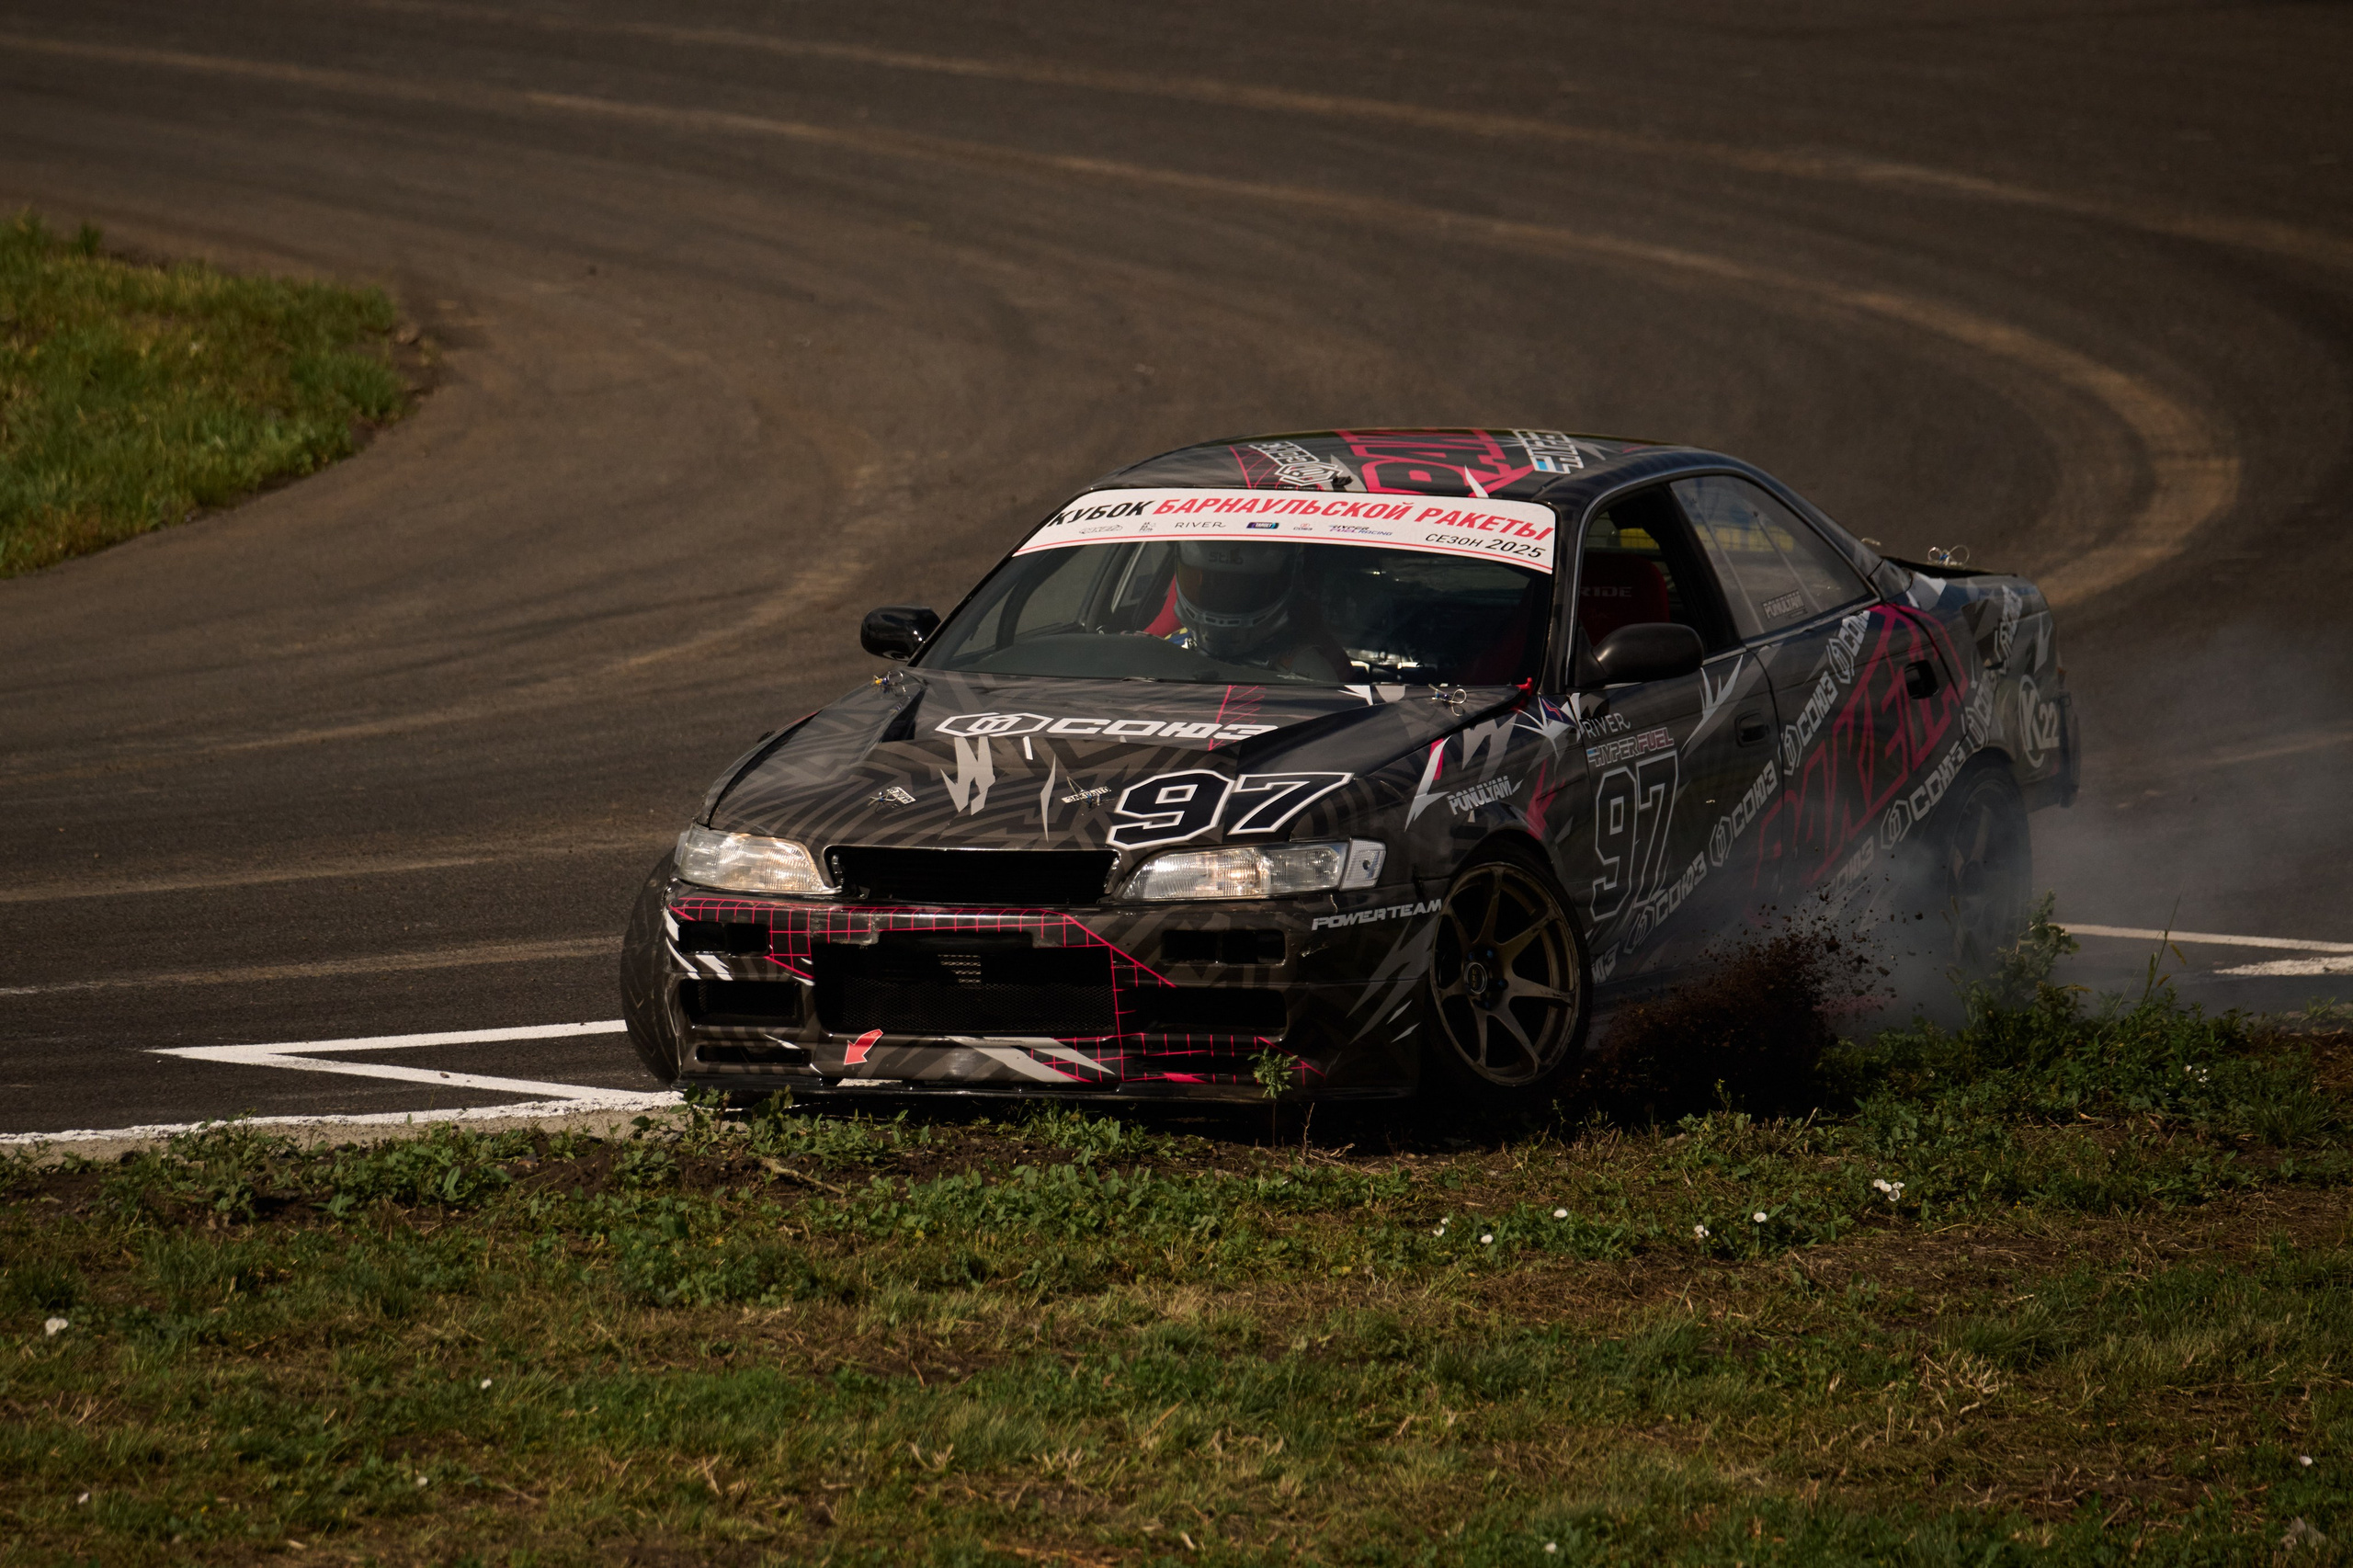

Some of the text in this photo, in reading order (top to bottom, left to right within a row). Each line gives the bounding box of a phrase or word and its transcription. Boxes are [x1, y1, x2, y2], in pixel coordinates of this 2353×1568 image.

[1047, 500, 1155, 528] КУБОК
[1153, 498, 1415, 521] БАРНАУЛЬСКОЙ
[1415, 507, 1555, 542] РАКЕТЫ
[1175, 521, 1226, 529] RIVER
[1426, 532, 1547, 558] СЕЗОН 2025
[1580, 585, 1632, 597] RIDE
[1582, 712, 1631, 739] RIVER
[1105, 768, 1356, 851] 97
[1447, 775, 1514, 816] PONULYAM
[1589, 749, 1679, 922] 97
